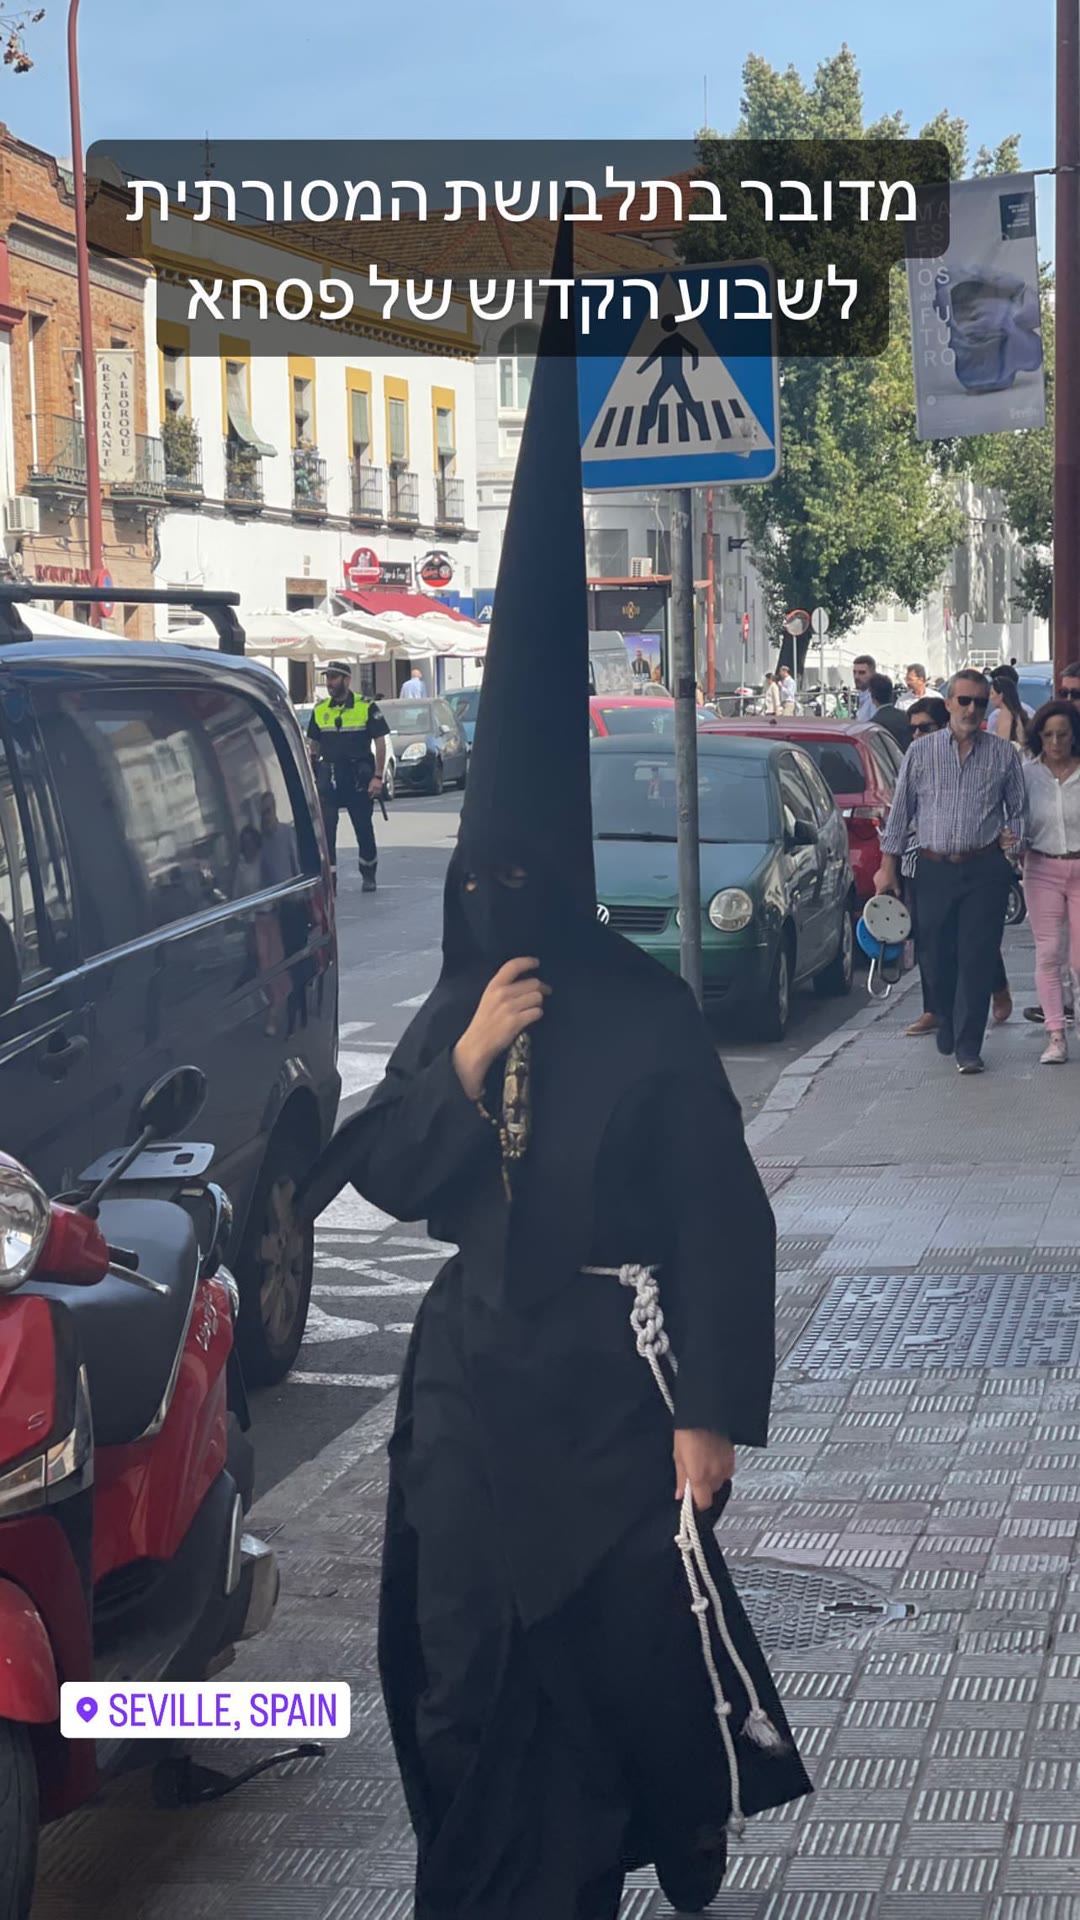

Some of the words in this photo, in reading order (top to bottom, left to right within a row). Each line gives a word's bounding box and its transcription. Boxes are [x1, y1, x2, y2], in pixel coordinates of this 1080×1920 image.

[918, 266, 950, 287] OS
[920, 305, 951, 325] FU
[920, 326, 951, 346] TU
[923, 347, 956, 368] RO
[101, 363, 112, 468] RESTAURANTE
[118, 371, 130, 457] ALBOROQUE
